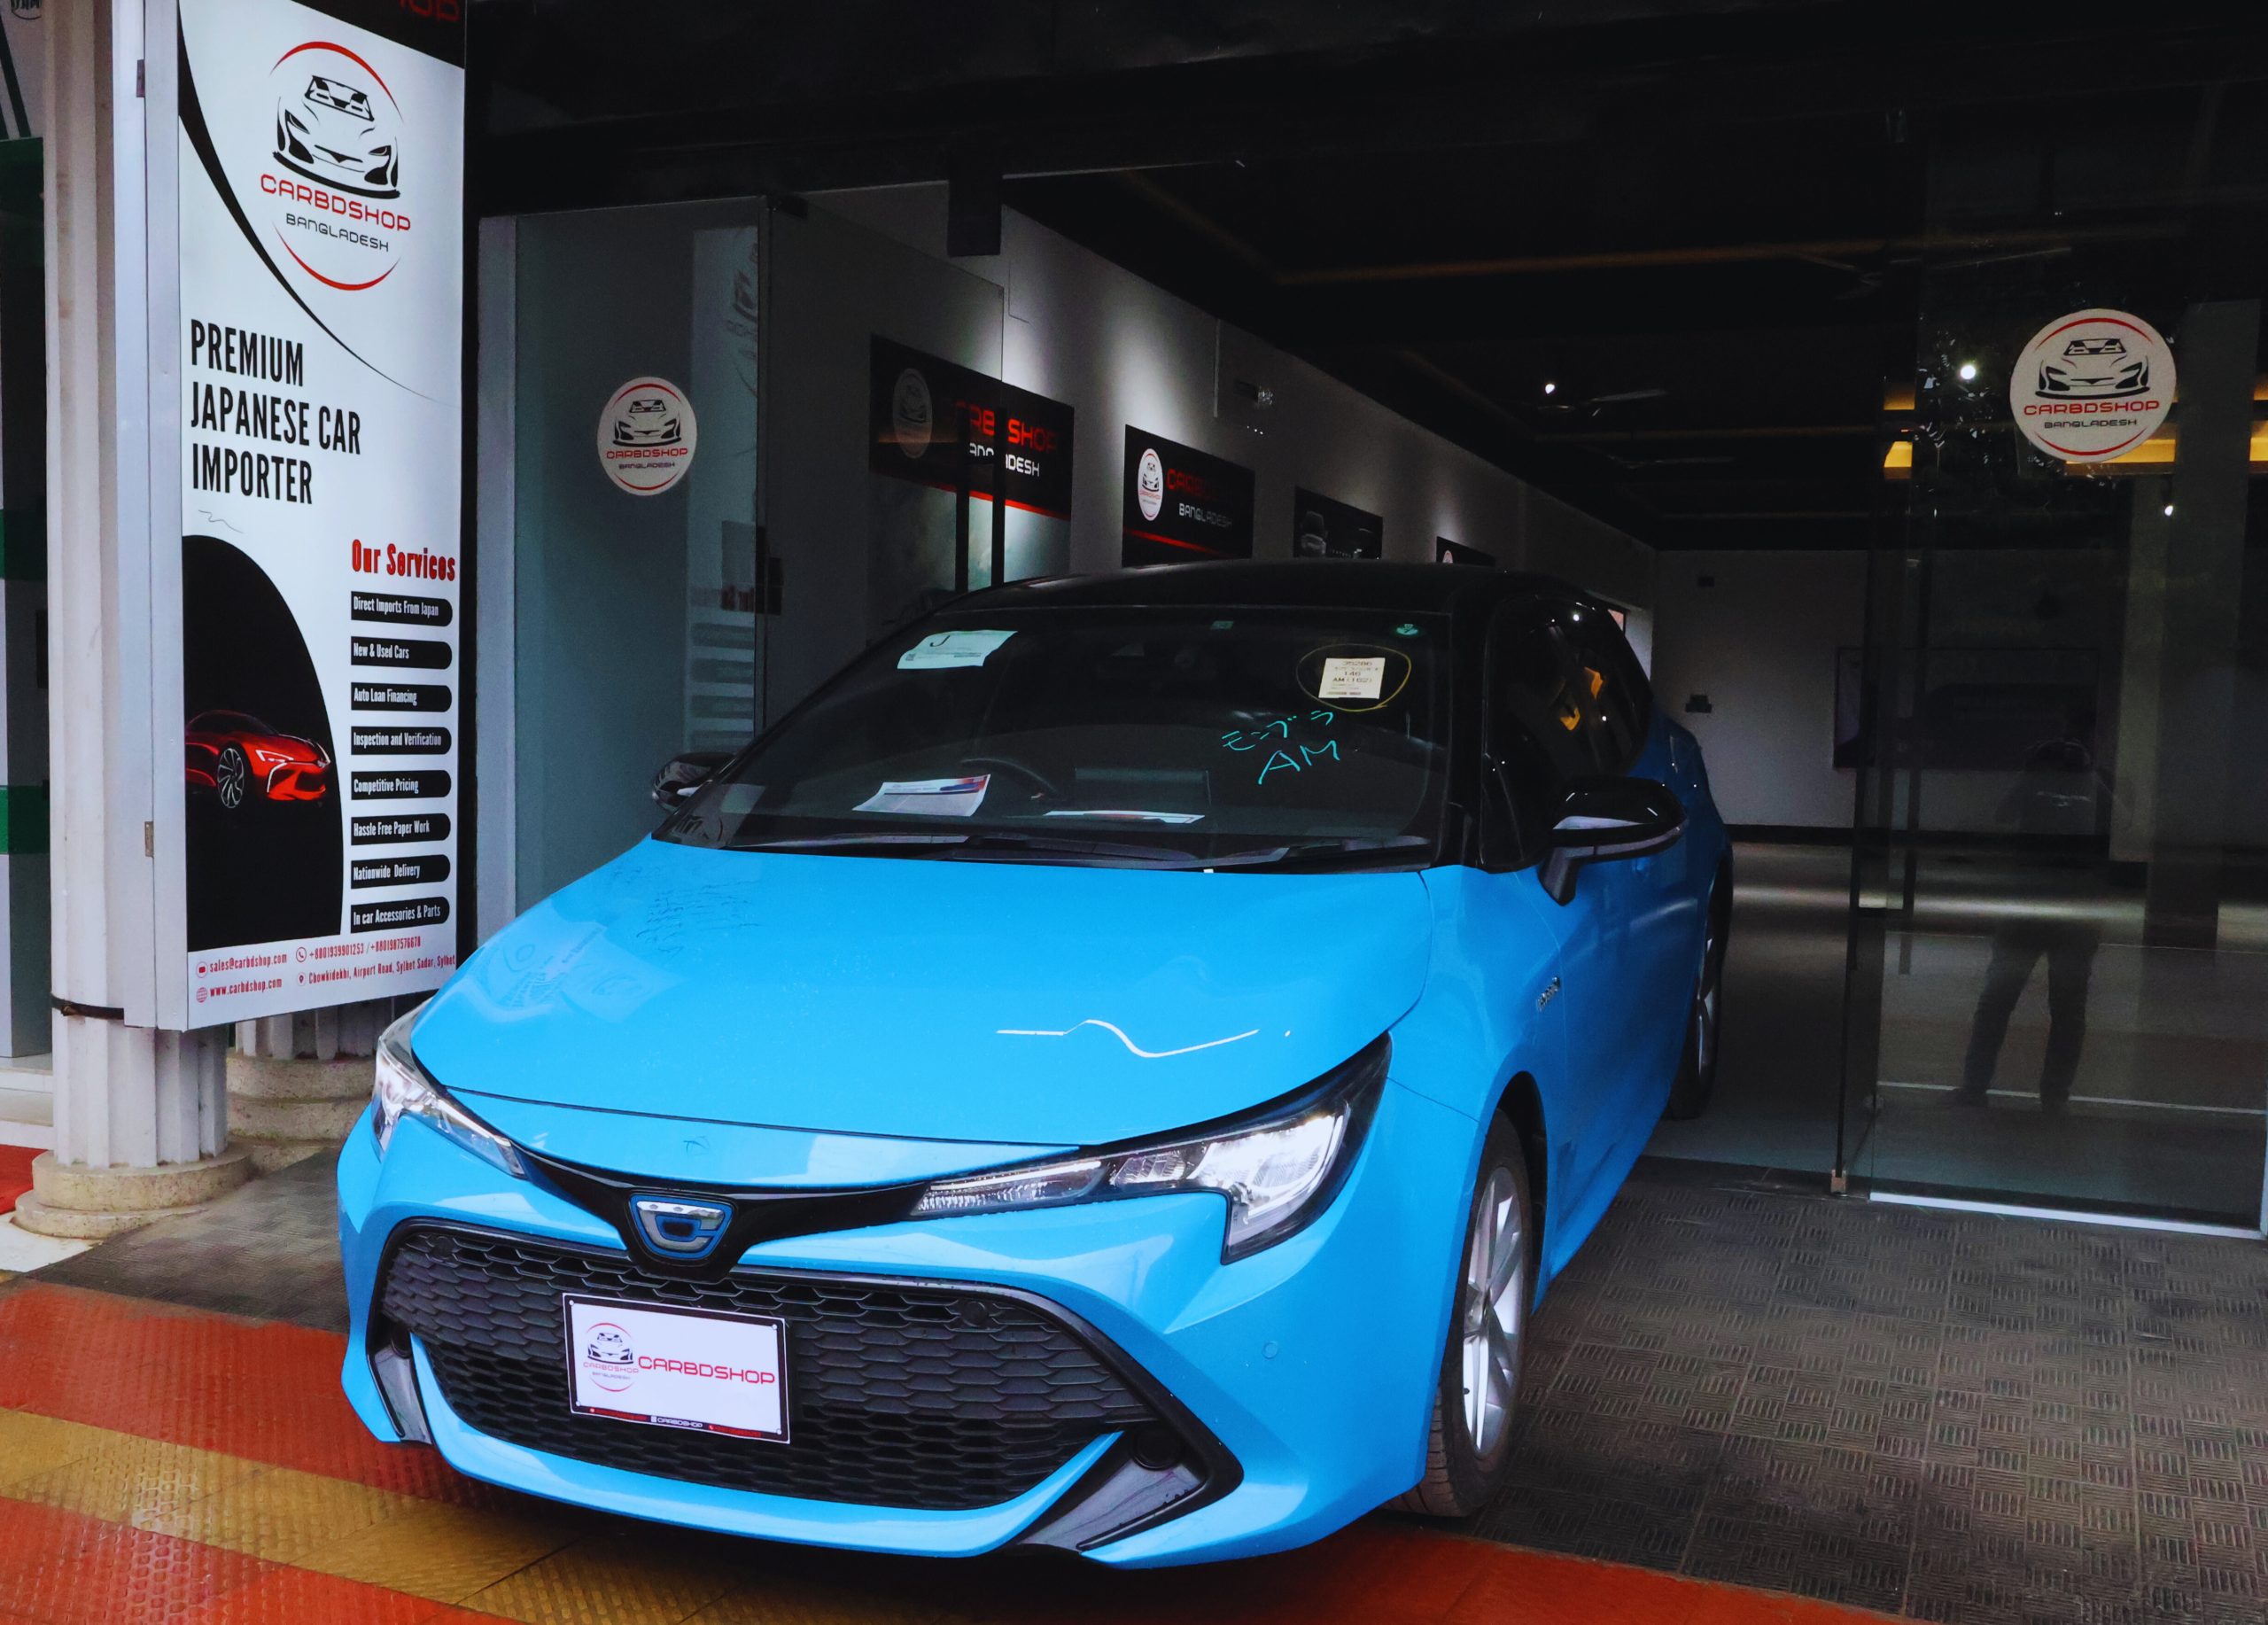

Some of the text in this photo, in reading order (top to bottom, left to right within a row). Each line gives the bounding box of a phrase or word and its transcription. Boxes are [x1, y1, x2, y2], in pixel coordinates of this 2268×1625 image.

[260, 174, 411, 231] CARBDSHOP
[286, 213, 389, 253] BANGLADESH
[191, 319, 303, 387] PREMIUM
[191, 381, 361, 455] JAPANESE CAR
[2023, 400, 2160, 416] CARBDSHOP
[2045, 419, 2137, 429] BANGLADESH
[606, 447, 687, 460] CARBDSHOP
[193, 443, 312, 504] IMPORTER
[352, 539, 455, 581] Our Services
[353, 596, 439, 618] Direct Imports From Japan
[353, 642, 409, 659] New & Used Cars
[353, 688, 417, 705] Auto Loan Financing
[353, 733, 441, 749] Inspection and Verification
[1258, 740, 1340, 784] AM
[353, 779, 418, 795] Competitive Pricing
[353, 820, 430, 836] Hassle Free Paper Work
[353, 865, 420, 880] Nationwide Delivery
[353, 905, 440, 925] In car Accessories & Parts
[209, 952, 287, 973] sales@carbdshop.com
[354, 964, 376, 978] Airport
[396, 960, 416, 973] Sylhet
[437, 955, 455, 968] Sylhet
[209, 977, 282, 998] www.carbdshop.com
[638, 1356, 775, 1385] CARBDSHOP
